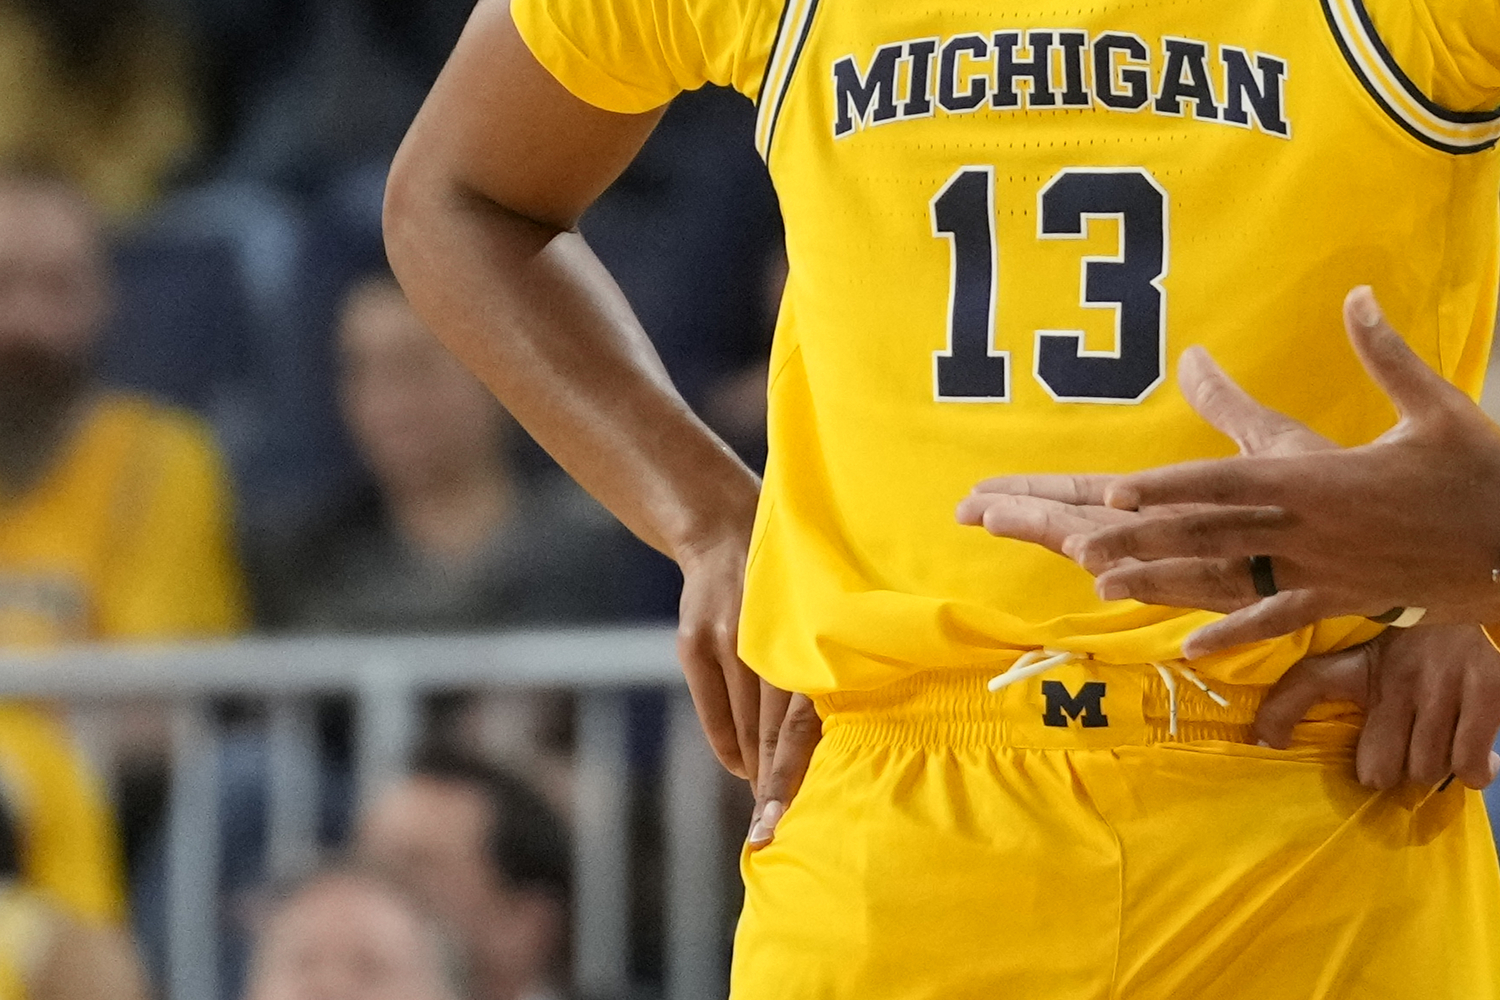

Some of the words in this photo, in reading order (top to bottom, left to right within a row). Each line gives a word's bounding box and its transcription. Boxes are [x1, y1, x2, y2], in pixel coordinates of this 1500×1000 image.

[833, 29, 1290, 139] MICHIGAN
[928, 165, 1169, 405] 13
[1041, 680, 1109, 728] M
